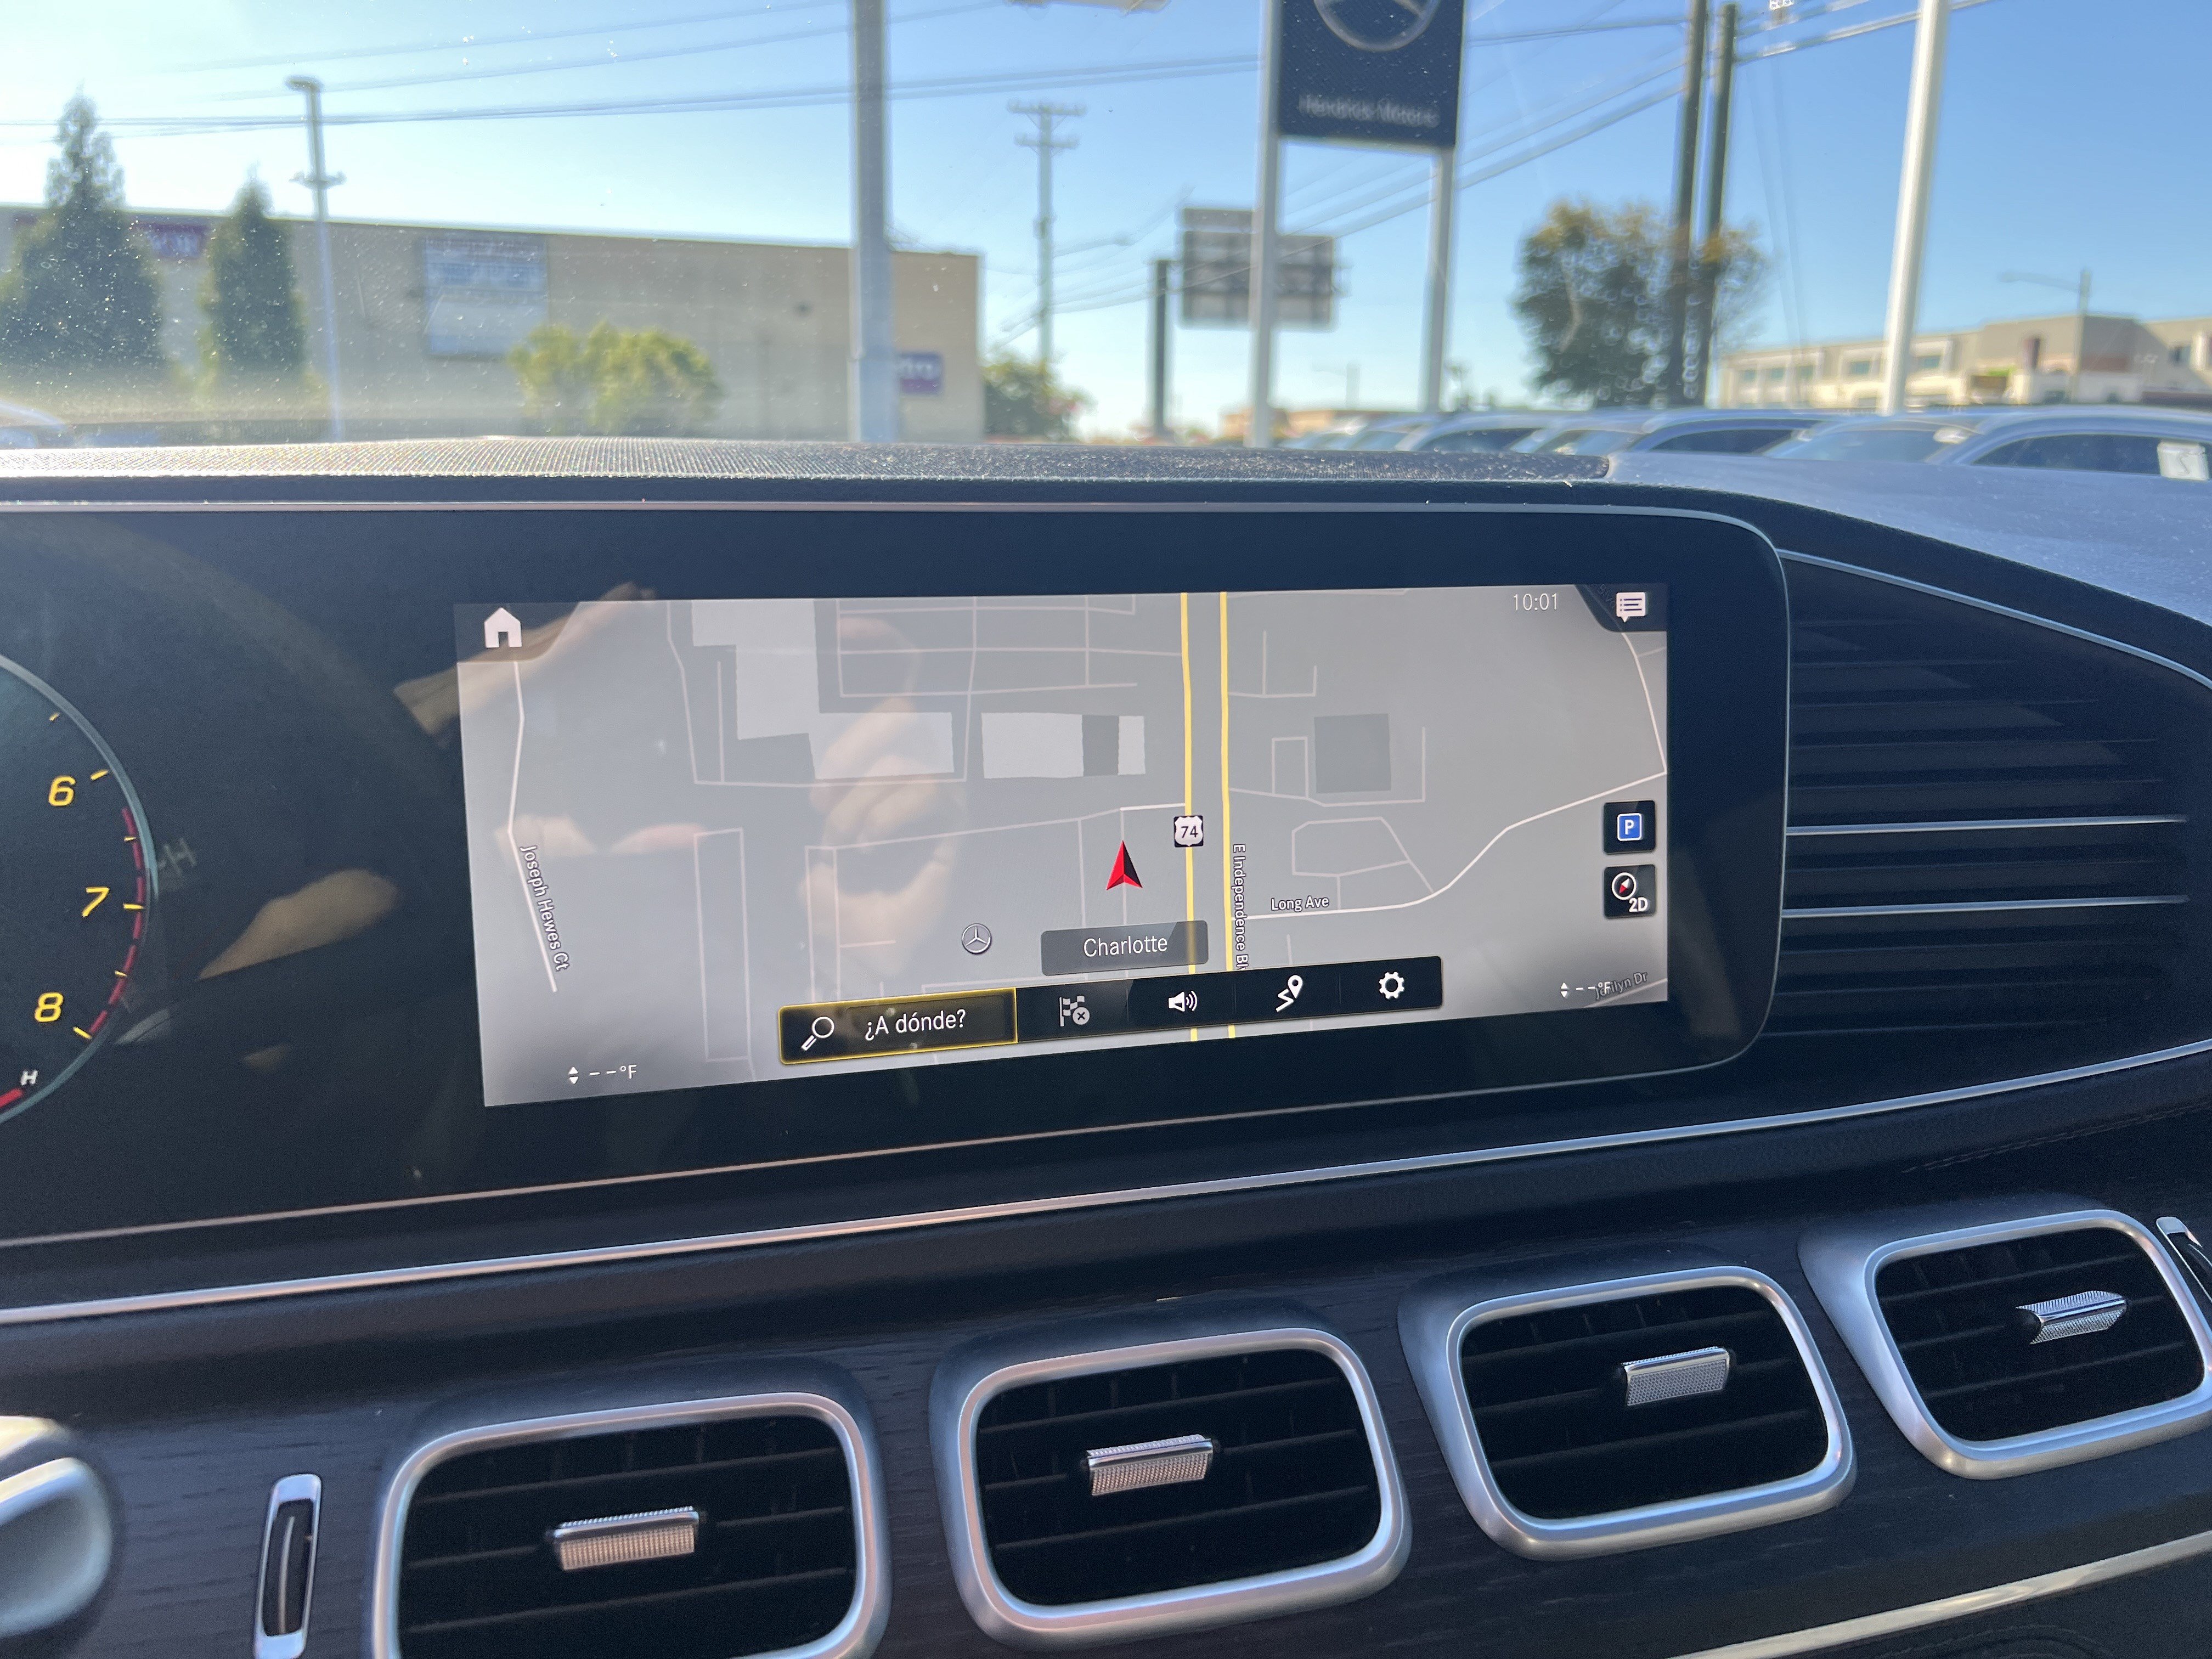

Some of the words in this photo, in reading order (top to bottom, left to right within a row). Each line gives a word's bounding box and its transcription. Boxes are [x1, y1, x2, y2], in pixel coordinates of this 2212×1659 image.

[1513, 592, 1558, 611] 10:01
[48, 775, 76, 806] 6
[1181, 825, 1199, 838] 74
[1624, 819, 1634, 836] P
[1233, 844, 1246, 853] E
[82, 886, 110, 917] 7
[520, 845, 548, 896] Joseph
[537, 898, 562, 950] Hewes
[553, 952, 570, 971] Ct
[1232, 856, 1248, 951] Independence
[1271, 898, 1302, 912] Long
[1305, 896, 1330, 909] Ave
[1628, 897, 1649, 913] 2D
[1083, 935, 1168, 958] Charlotte
[1633, 972, 1648, 985] Dr
[35, 992, 64, 1023] 8
[864, 1016, 889, 1041] ¿A
[895, 1008, 967, 1034] dónde?
[21, 1070, 38, 1086] H
